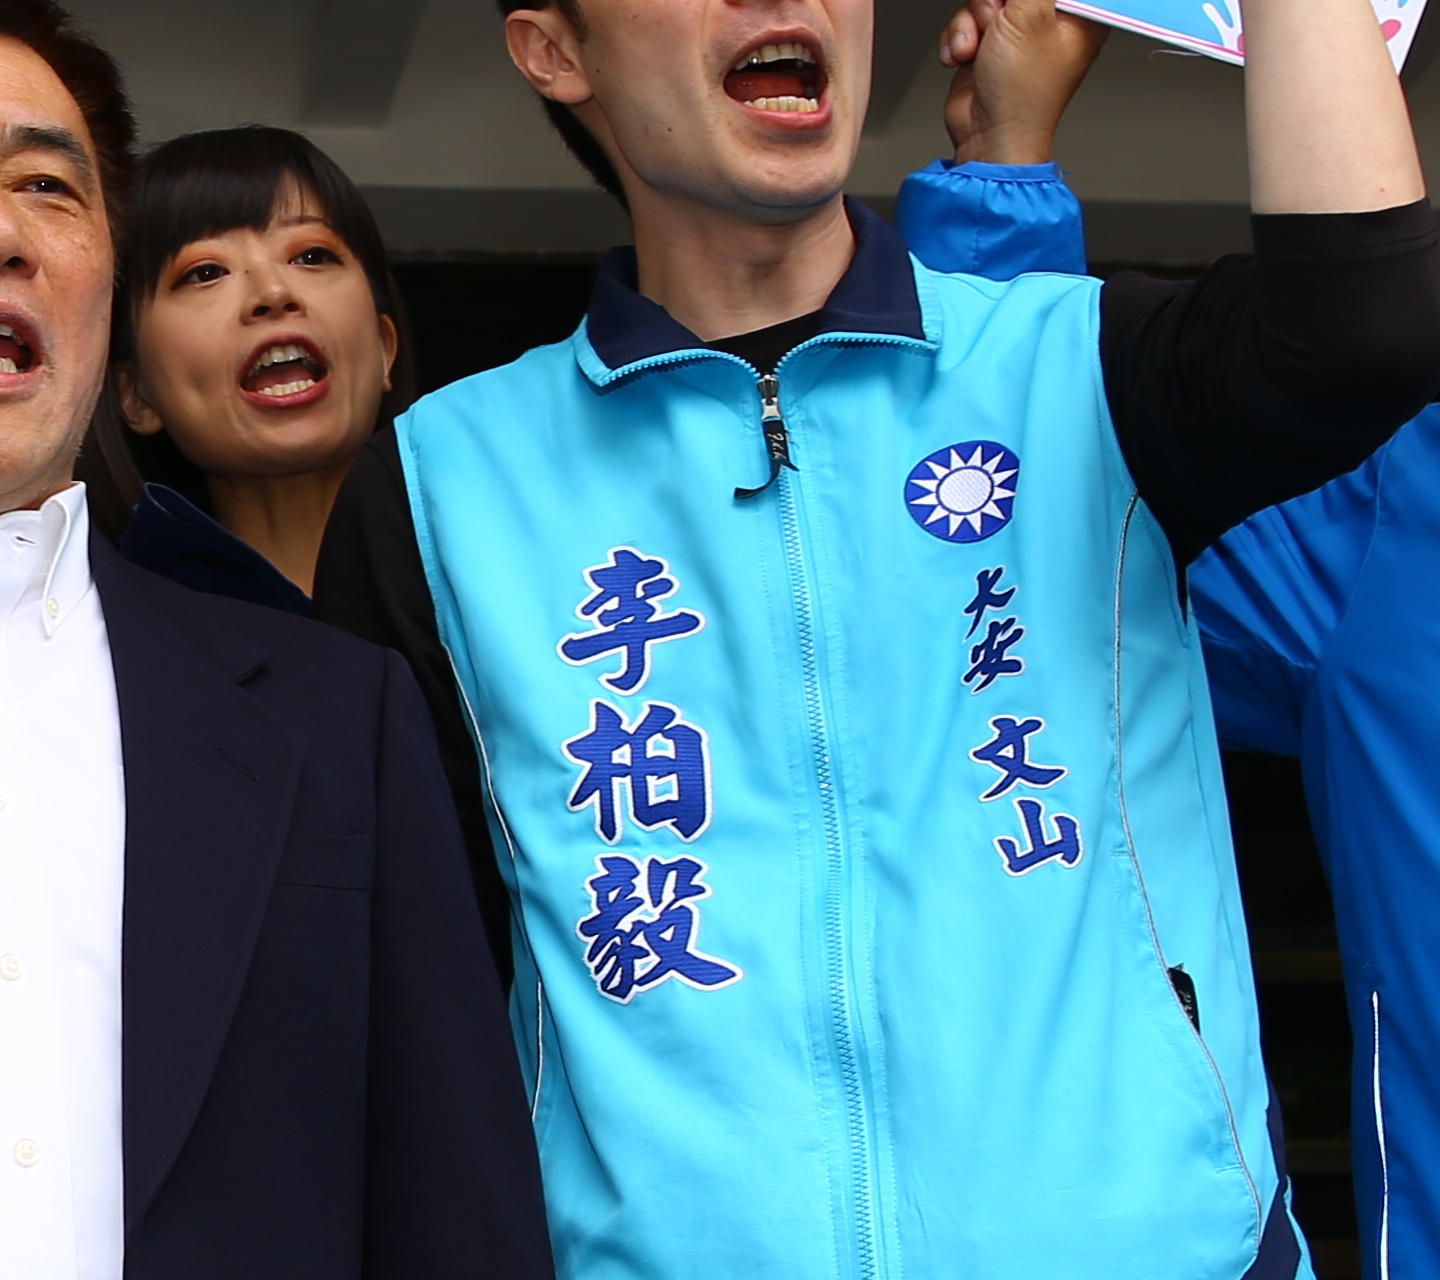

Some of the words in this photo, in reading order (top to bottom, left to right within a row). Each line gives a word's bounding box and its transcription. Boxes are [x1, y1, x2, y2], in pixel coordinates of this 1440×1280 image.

[962, 565, 1026, 696] 大安
[557, 546, 742, 1005] 李柏毅
[968, 714, 1083, 878] 文山
